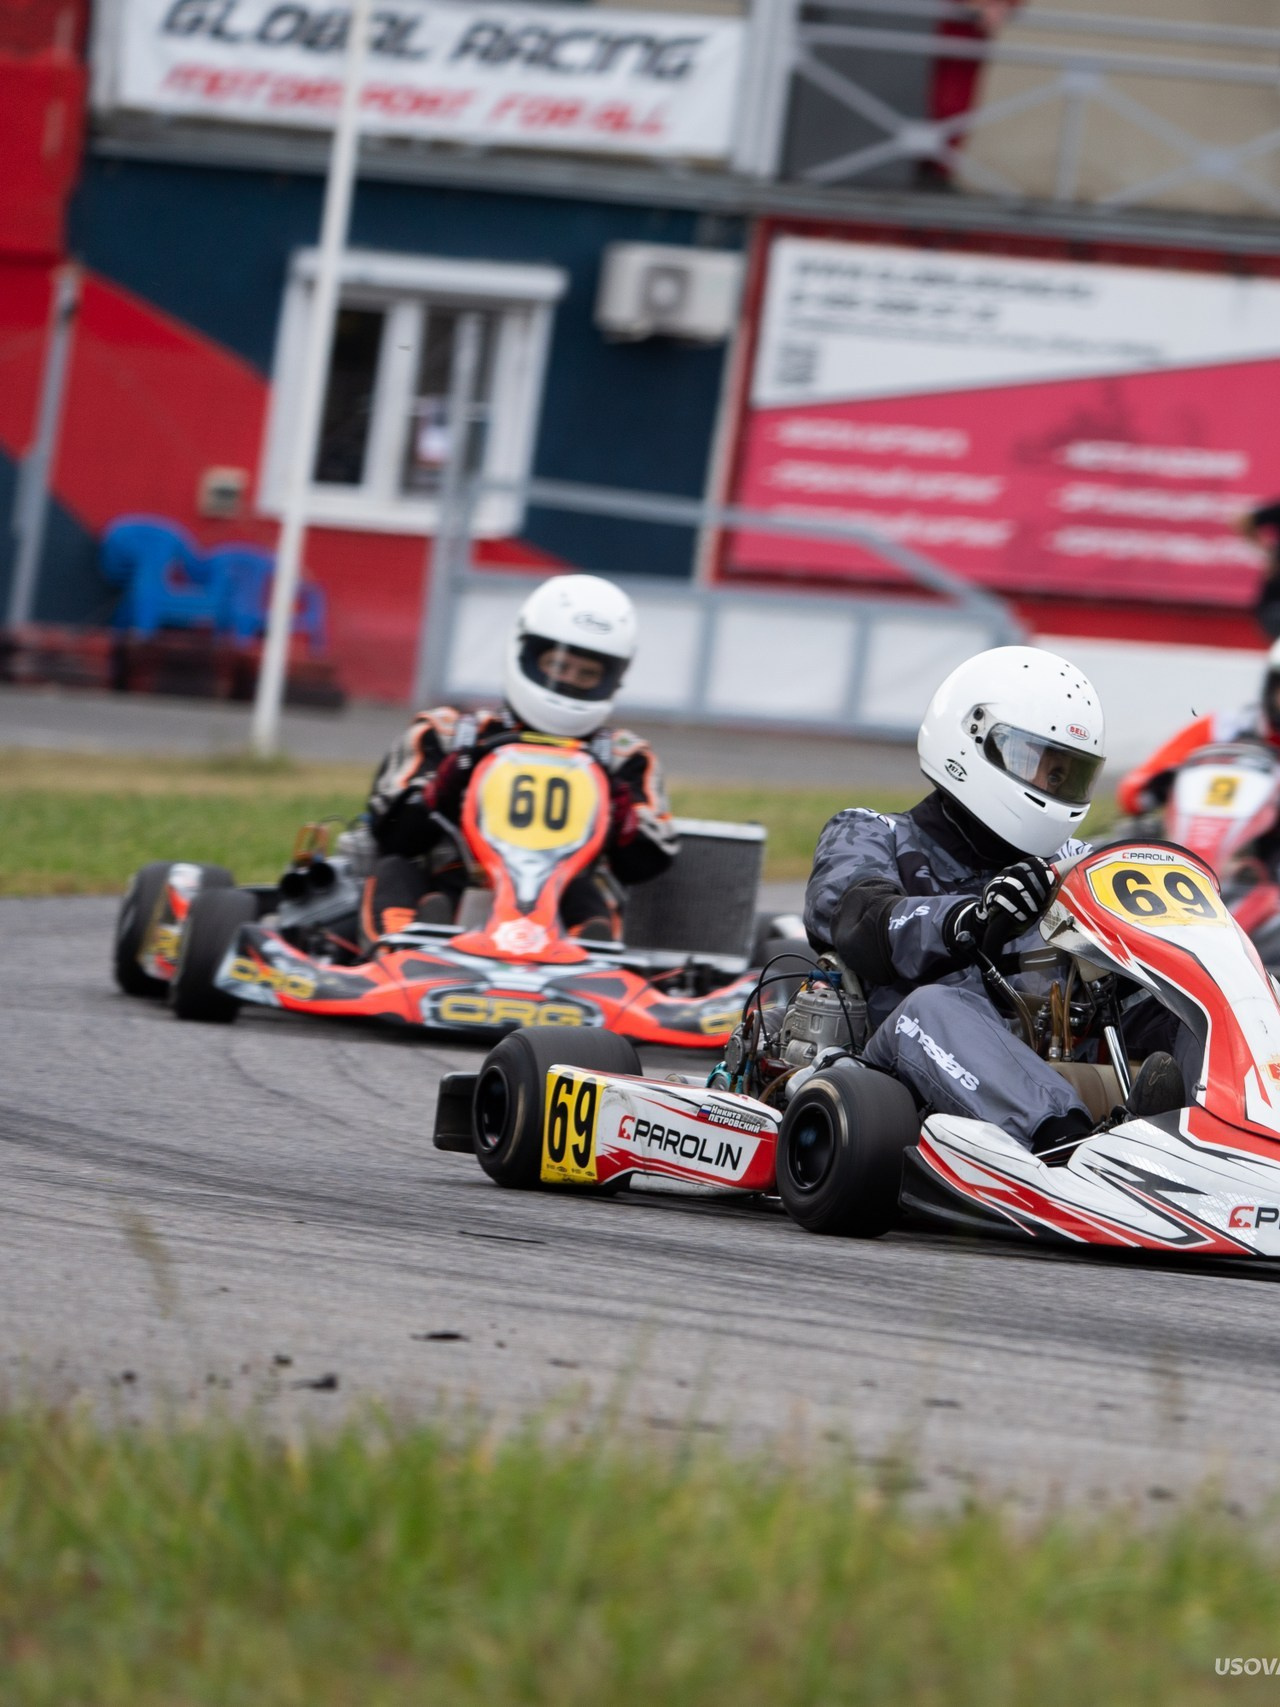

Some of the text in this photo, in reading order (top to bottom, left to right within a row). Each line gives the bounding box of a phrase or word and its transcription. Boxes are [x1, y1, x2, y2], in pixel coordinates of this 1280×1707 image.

[162, 0, 708, 82] GLOBAL RACING
[1069, 725, 1088, 738] BELL
[508, 774, 570, 831] 60
[1111, 869, 1218, 919] 69
[440, 994, 585, 1027] CRG
[547, 1071, 597, 1169] 69
[707, 1113, 760, 1134] ПЕТРОВСКИЙ
[711, 1104, 742, 1120] Никита
